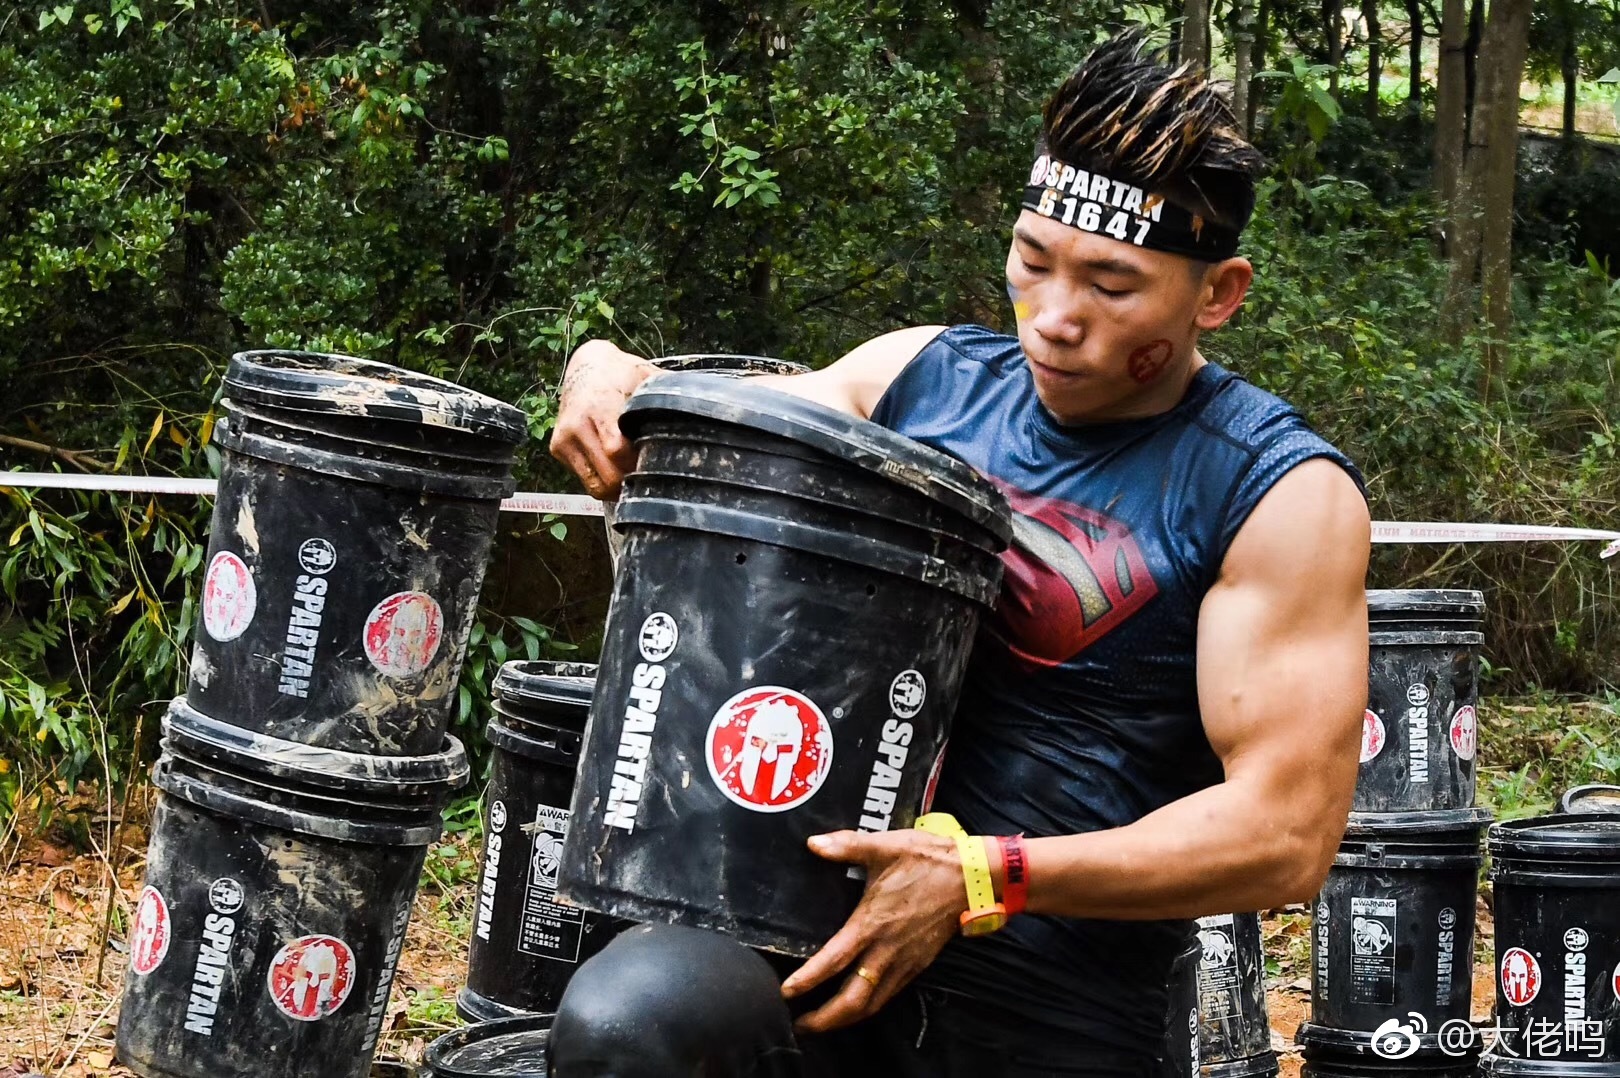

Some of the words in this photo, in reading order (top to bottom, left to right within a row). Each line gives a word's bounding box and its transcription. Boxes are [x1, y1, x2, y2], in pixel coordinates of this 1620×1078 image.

[1046, 160, 1165, 223] SPARTAN
[278, 574, 328, 699] SPARTAN
[603, 662, 666, 835] SPARTAN
[1409, 706, 1428, 783] SPARTAN
[847, 719, 913, 880] SPART
[477, 833, 502, 942] SPARTAN
[184, 912, 235, 1036] SPARTAN
[1317, 925, 1329, 1001] SPARTAN
[1436, 931, 1456, 1006] SPARTAN
